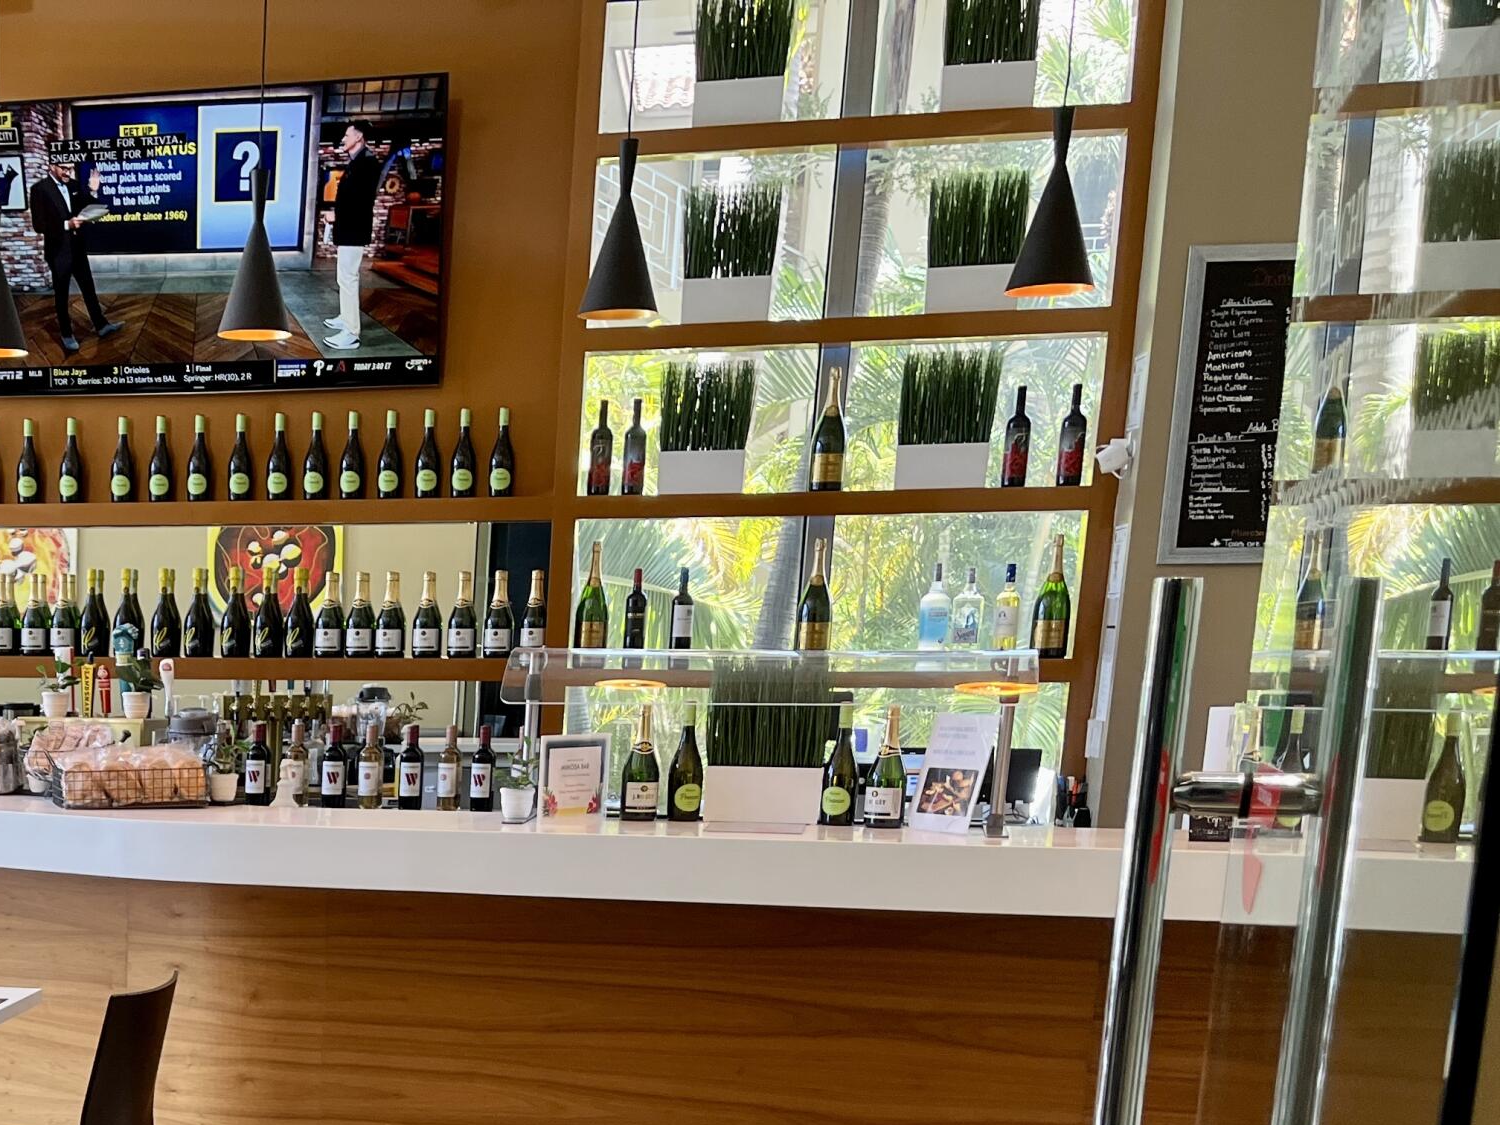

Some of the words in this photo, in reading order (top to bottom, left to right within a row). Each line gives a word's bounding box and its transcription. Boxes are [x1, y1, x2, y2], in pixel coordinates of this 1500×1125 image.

[123, 127, 140, 136] GET
[142, 126, 153, 135] UP
[50, 141, 62, 151] IT
[68, 140, 80, 150] IS
[86, 139, 111, 149] TIME
[117, 138, 135, 148] FOR
[141, 135, 183, 146] TRIVIA.
[51, 153, 86, 163] SNEAKY
[93, 151, 117, 161] TIME
[123, 150, 141, 159] FOR
[96, 162, 120, 172] Which
[122, 161, 149, 171] former
[151, 159, 165, 170] No.
[167, 159, 173, 169] 1
[119, 172, 137, 184] pick
[138, 171, 153, 182] has
[154, 170, 182, 181] scored
[103, 186, 116, 195] the
[118, 184, 144, 194] fewest
[145, 184, 170, 195] points
[123, 195, 136, 206] the
[137, 194, 160, 205] NBA?
[123, 212, 141, 221] draft
[143, 211, 162, 220] since
[164, 210, 188, 221] 1966)
[1207, 349, 1252, 361] Americano
[53, 368, 69, 376] Blue
[71, 368, 87, 377] Jays
[113, 366, 118, 374] 3
[123, 366, 150, 374] Orioles
[119, 376, 125, 384] in
[1203, 372, 1233, 383] Regular
[1203, 384, 1222, 392] Iced
